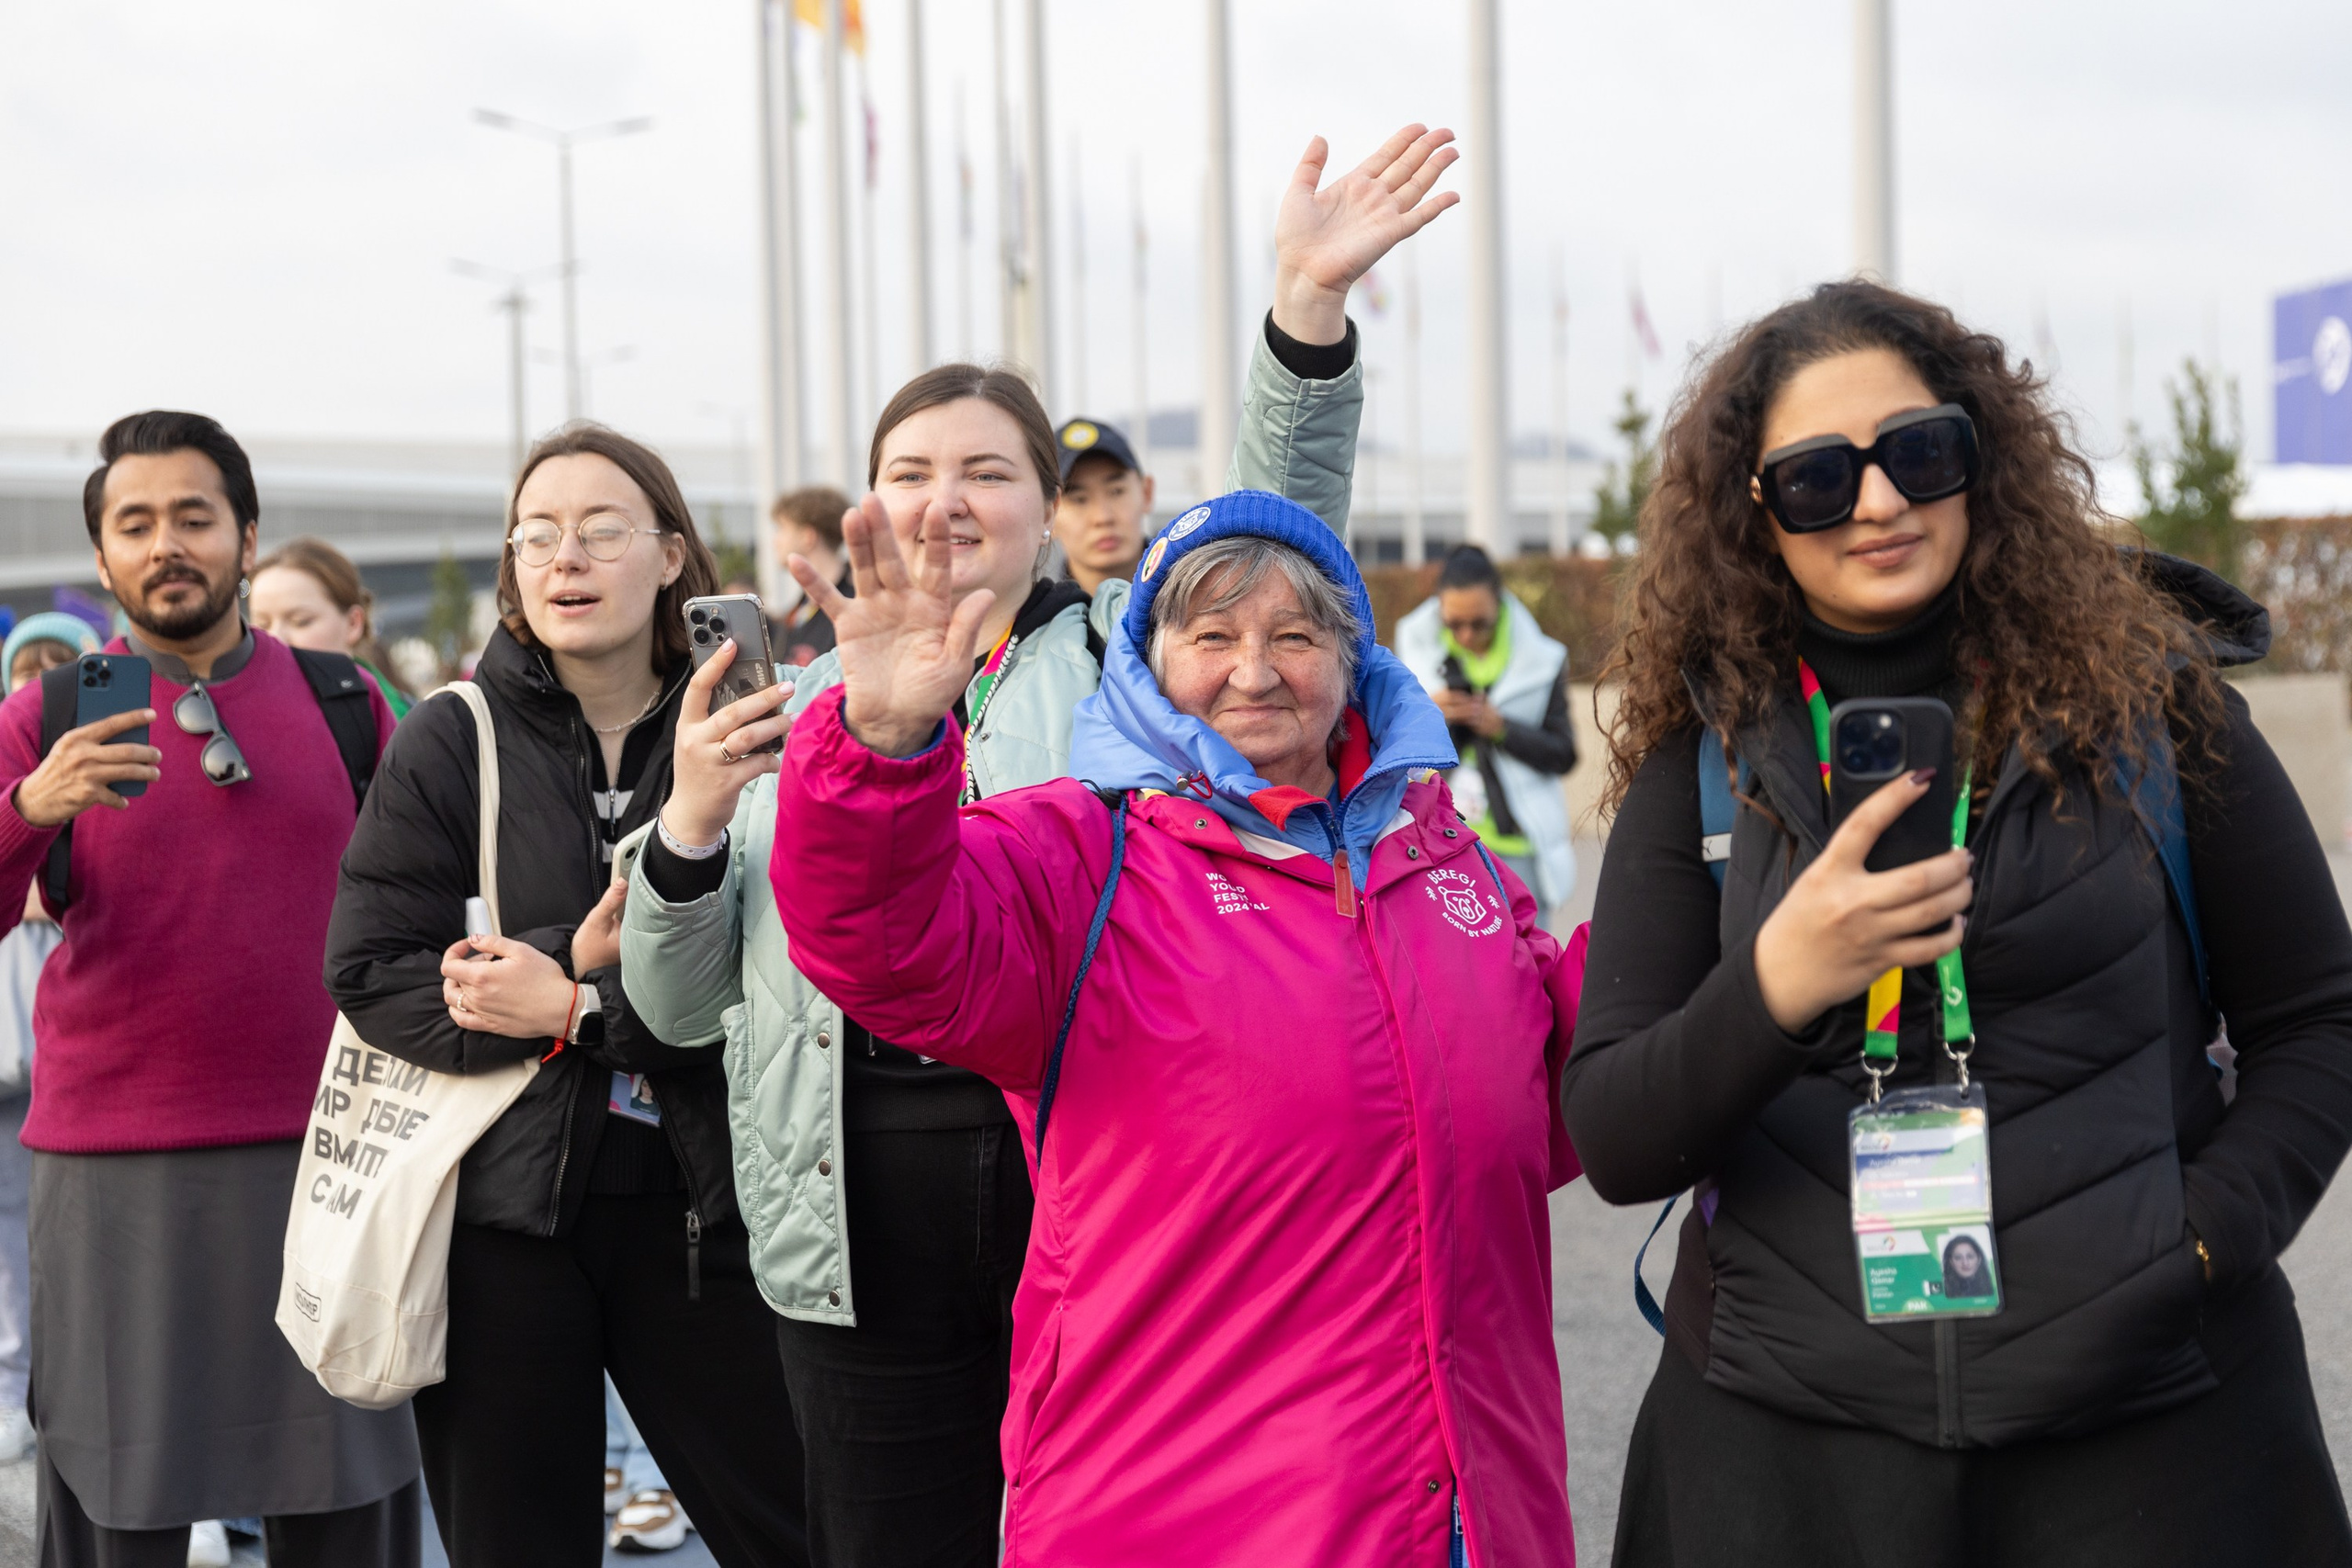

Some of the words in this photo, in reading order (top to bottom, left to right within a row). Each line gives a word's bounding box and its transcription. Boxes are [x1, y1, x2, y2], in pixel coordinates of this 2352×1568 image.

[1427, 869, 1476, 887] BEREGI
[1442, 912, 1466, 933] BORN
[1480, 916, 1502, 935] NATURE
[1907, 1300, 1928, 1311] PAK
